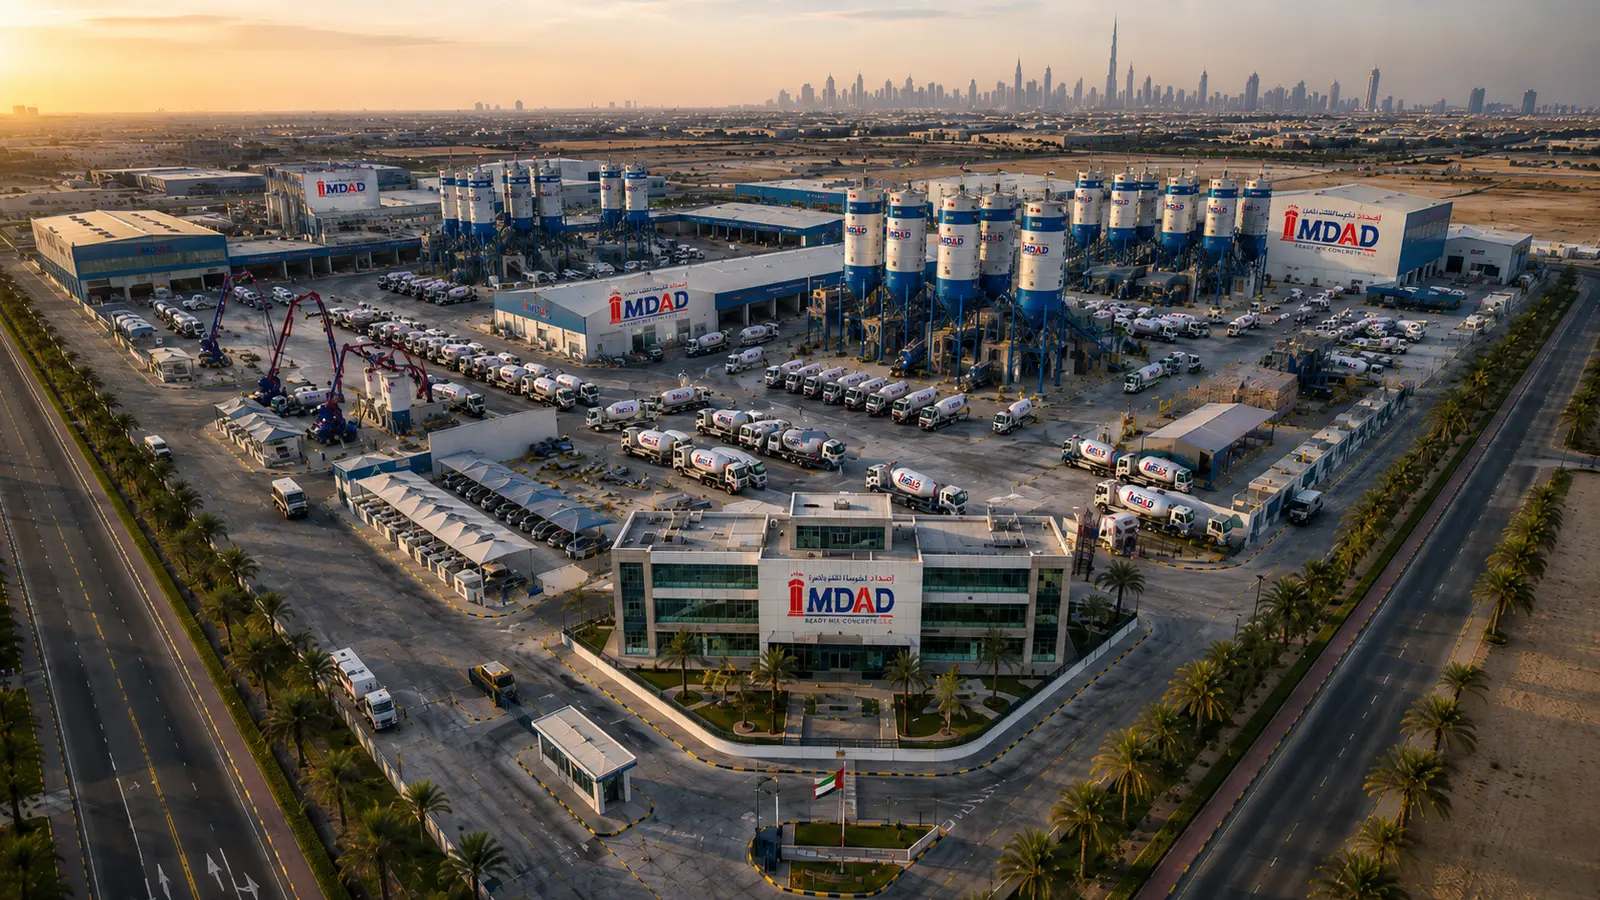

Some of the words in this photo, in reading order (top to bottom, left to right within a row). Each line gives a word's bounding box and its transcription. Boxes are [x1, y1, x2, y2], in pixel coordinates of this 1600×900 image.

[317, 180, 365, 197] IMDAD
[1280, 209, 1380, 248] IMDAD
[609, 290, 689, 325] IMDAD
[787, 578, 895, 617] IMDAD
